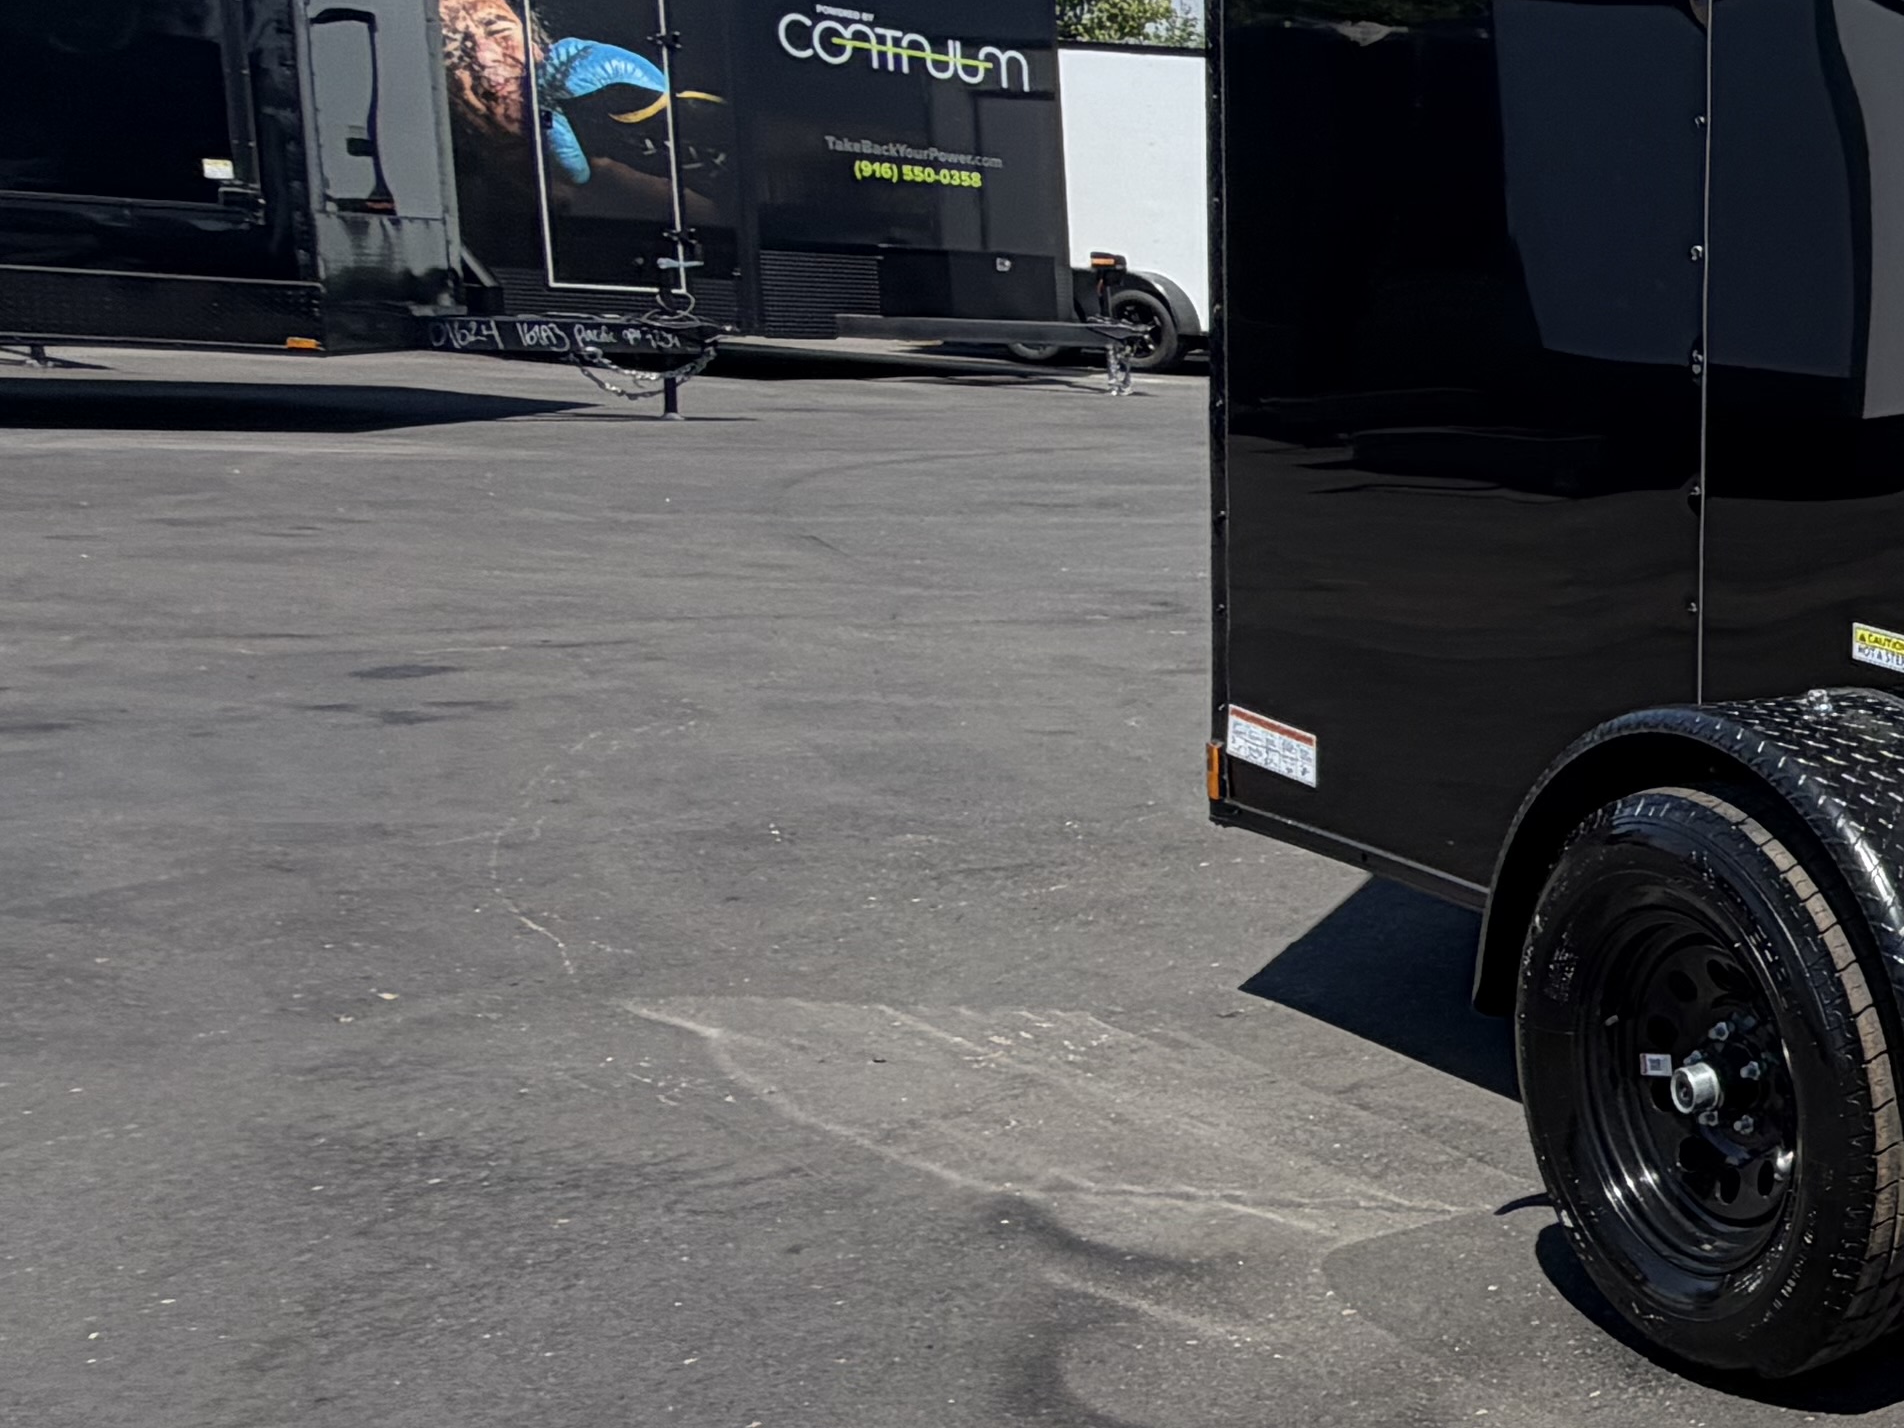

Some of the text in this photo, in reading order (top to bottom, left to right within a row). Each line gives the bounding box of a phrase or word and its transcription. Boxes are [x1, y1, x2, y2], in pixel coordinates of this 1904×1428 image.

[824, 135, 1003, 168] TakeBackYourPower.com
[854, 160, 983, 188] (916) 550-0358
[1858, 645, 1876, 658] NOT
